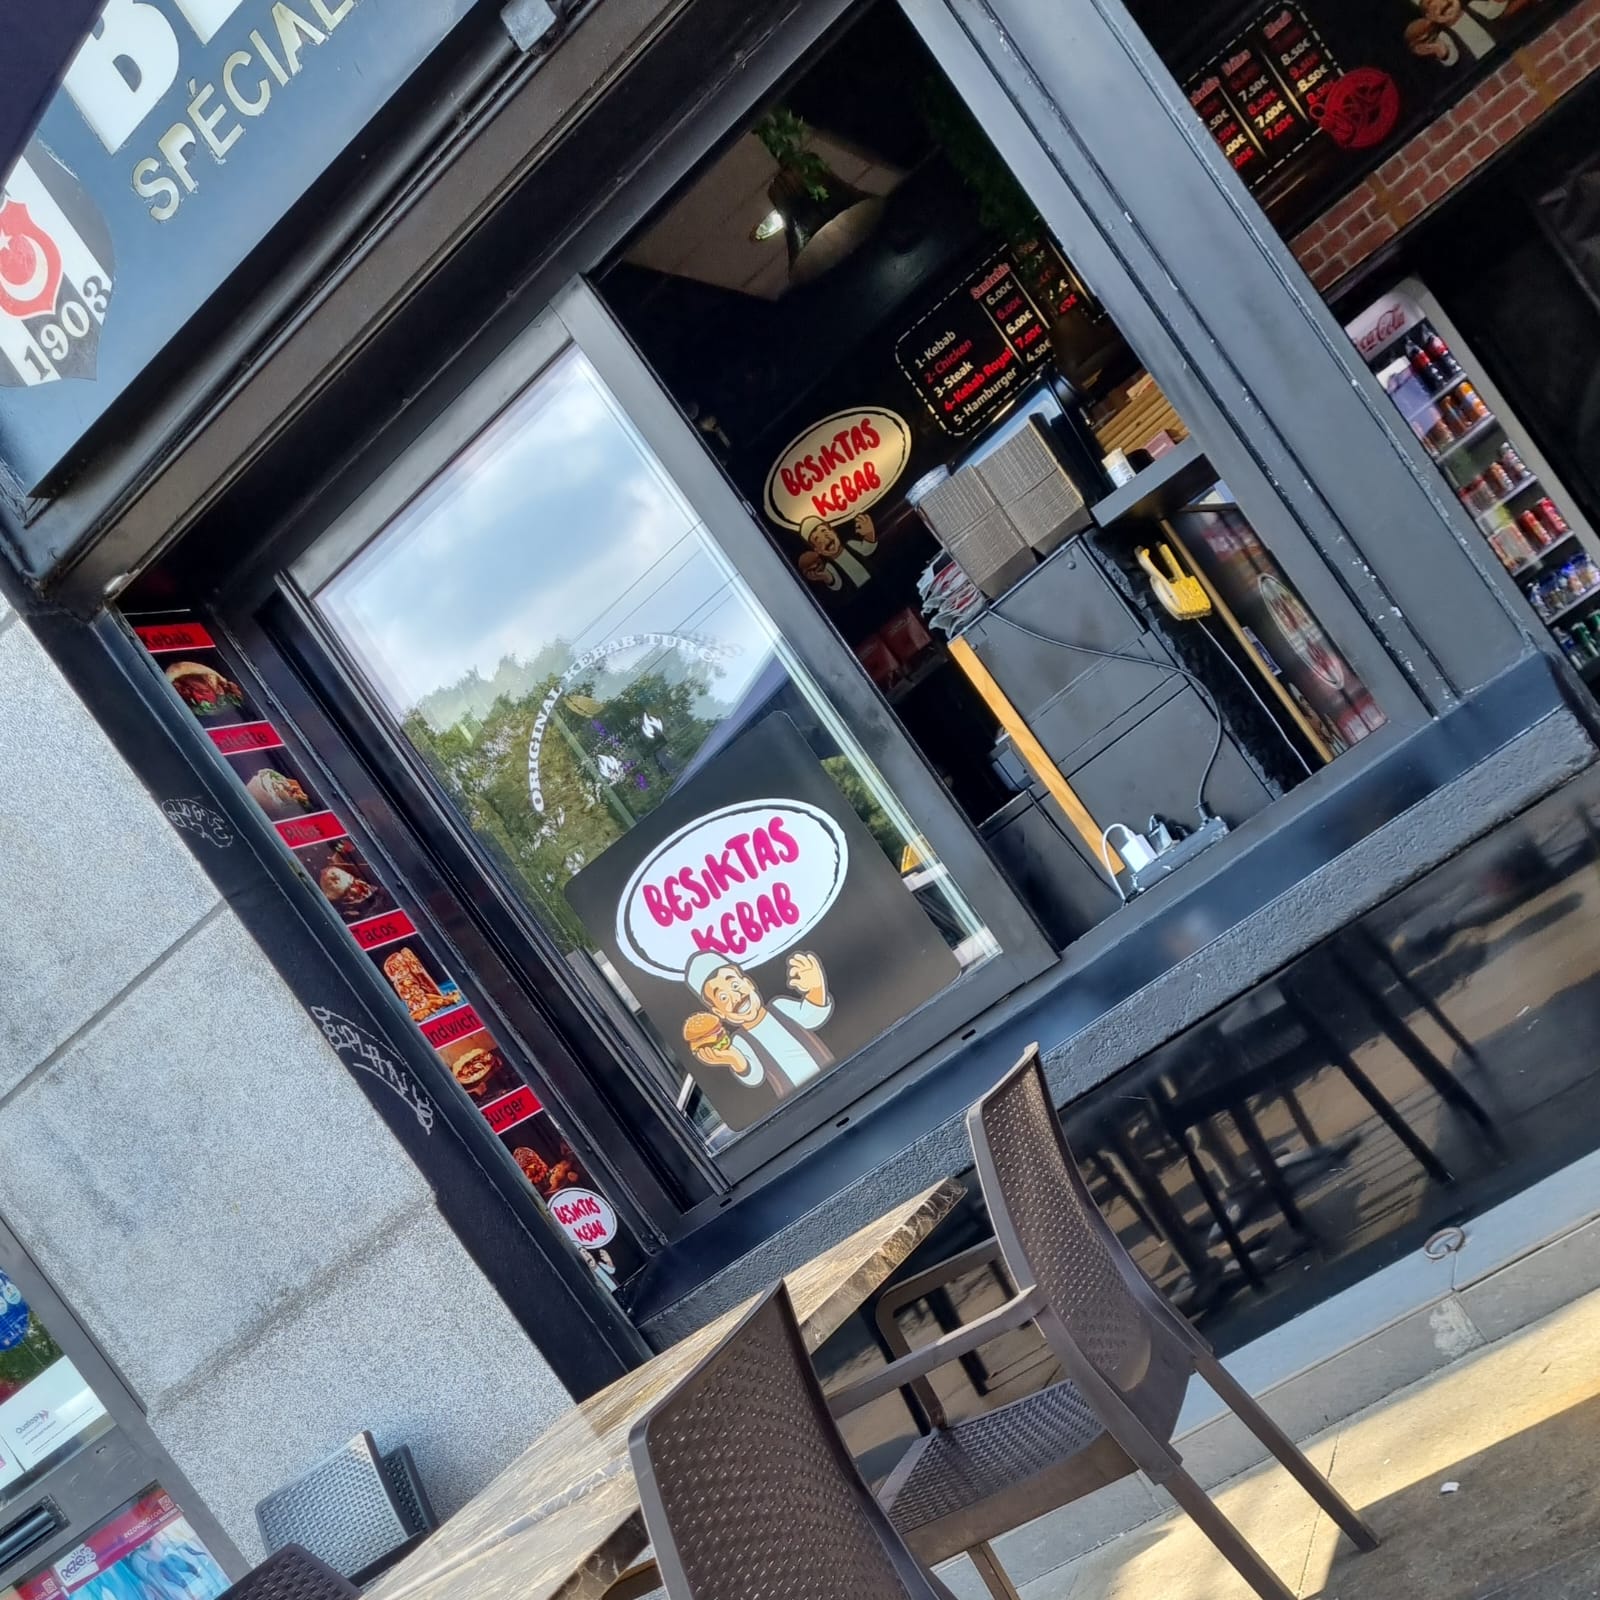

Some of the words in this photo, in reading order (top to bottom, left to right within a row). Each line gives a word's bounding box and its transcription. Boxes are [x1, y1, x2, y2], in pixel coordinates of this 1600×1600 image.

[1280, 37, 1312, 66] 8.50€
[1238, 74, 1270, 103] 7.50€
[1296, 64, 1329, 93] 8.50€
[1209, 108, 1230, 130] .50€
[1254, 100, 1287, 129] 7.00€
[1263, 113, 1294, 141] 7.00€
[1225, 133, 1247, 157] .00€
[986, 280, 1013, 306] 6.00€
[996, 296, 1022, 320] 6.00€
[1005, 309, 1033, 335] 6.00€
[24, 275, 112, 379] 1903
[1014, 323, 1043, 349] 7.00€
[982, 346, 1014, 377] Royal
[1026, 338, 1051, 363] 4.50€
[780, 417, 881, 497] BESIKTAS
[811, 461, 881, 517] KEBAB
[528, 686, 563, 812] ORIGINAL
[563, 633, 638, 684] KEBAB
[216, 729, 269, 749] alette
[285, 822, 325, 842] Pitas
[642, 816, 799, 928] BESIKTAS
[352, 922, 397, 944] Tacos
[690, 882, 800, 955] KEBAB
[425, 1013, 479, 1044] ndwich
[554, 1195, 601, 1225] BESIKTAS
[574, 1217, 607, 1242] KEBAB
